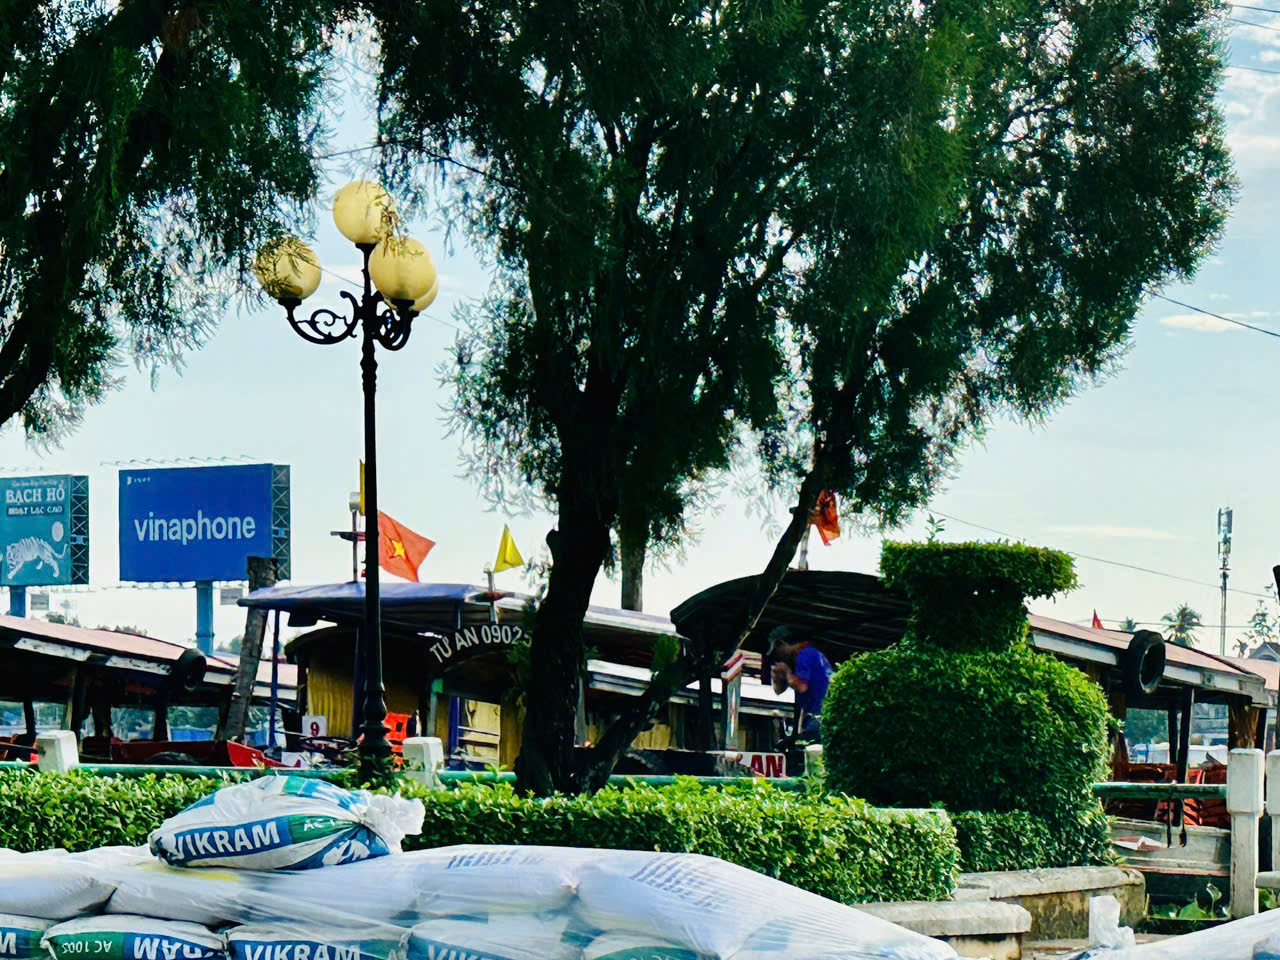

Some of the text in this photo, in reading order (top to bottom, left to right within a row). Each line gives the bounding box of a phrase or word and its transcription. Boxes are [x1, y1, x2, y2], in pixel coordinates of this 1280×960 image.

[5, 487, 42, 506] BẠCH
[133, 510, 256, 546] vinaphone
[455, 626, 480, 651] AN
[310, 721, 320, 737] 9
[174, 821, 281, 860] VIKRAM
[61, 936, 214, 960] AC 100S RAM
